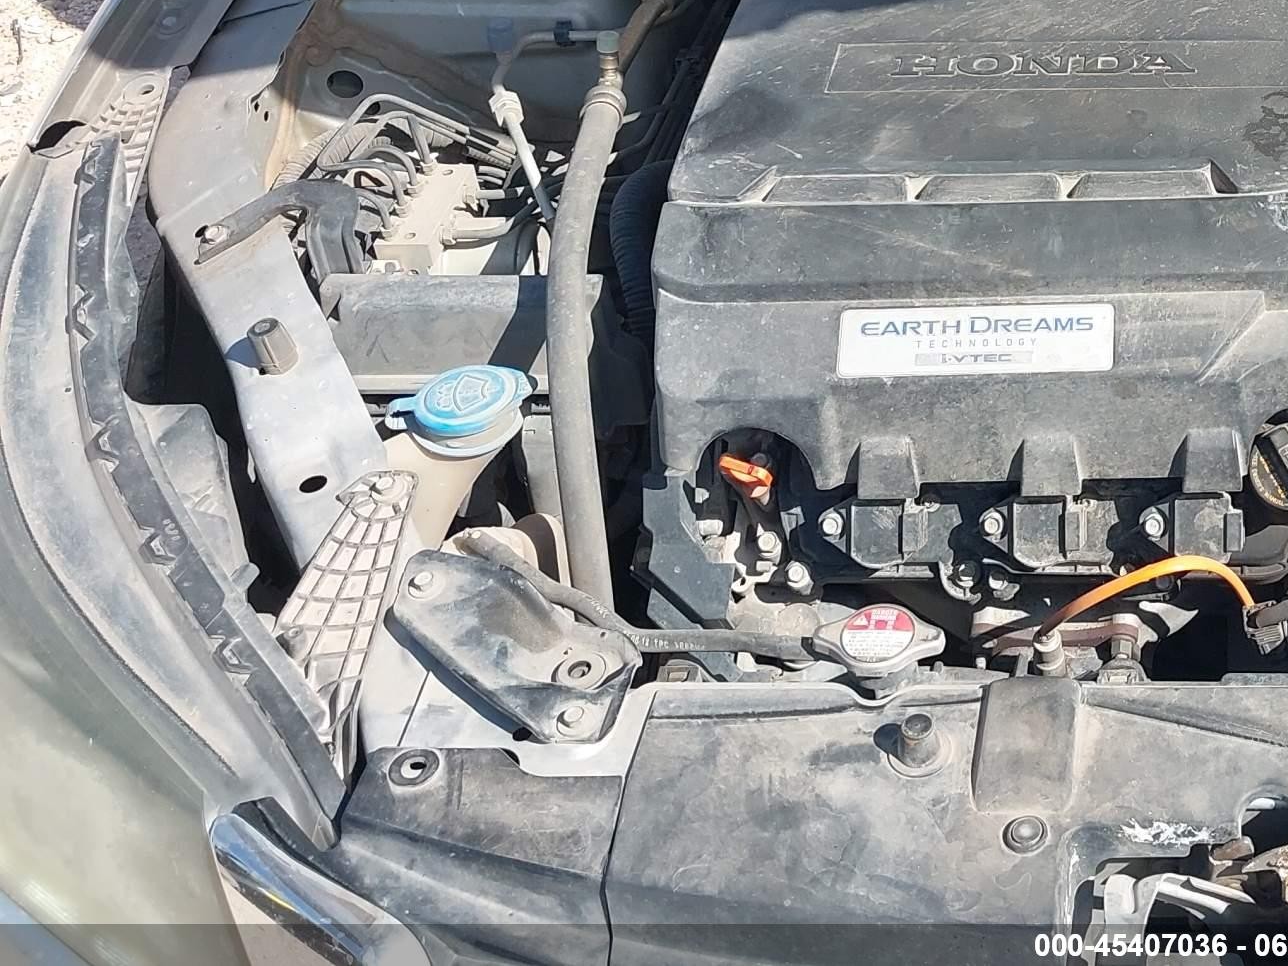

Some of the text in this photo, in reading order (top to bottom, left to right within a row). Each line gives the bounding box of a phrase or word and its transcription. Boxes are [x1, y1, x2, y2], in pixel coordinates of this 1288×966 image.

[890, 52, 1197, 77] HONDA
[860, 316, 1094, 337] EARTH DREAMS
[915, 338, 1038, 349] TECHNOLOGY
